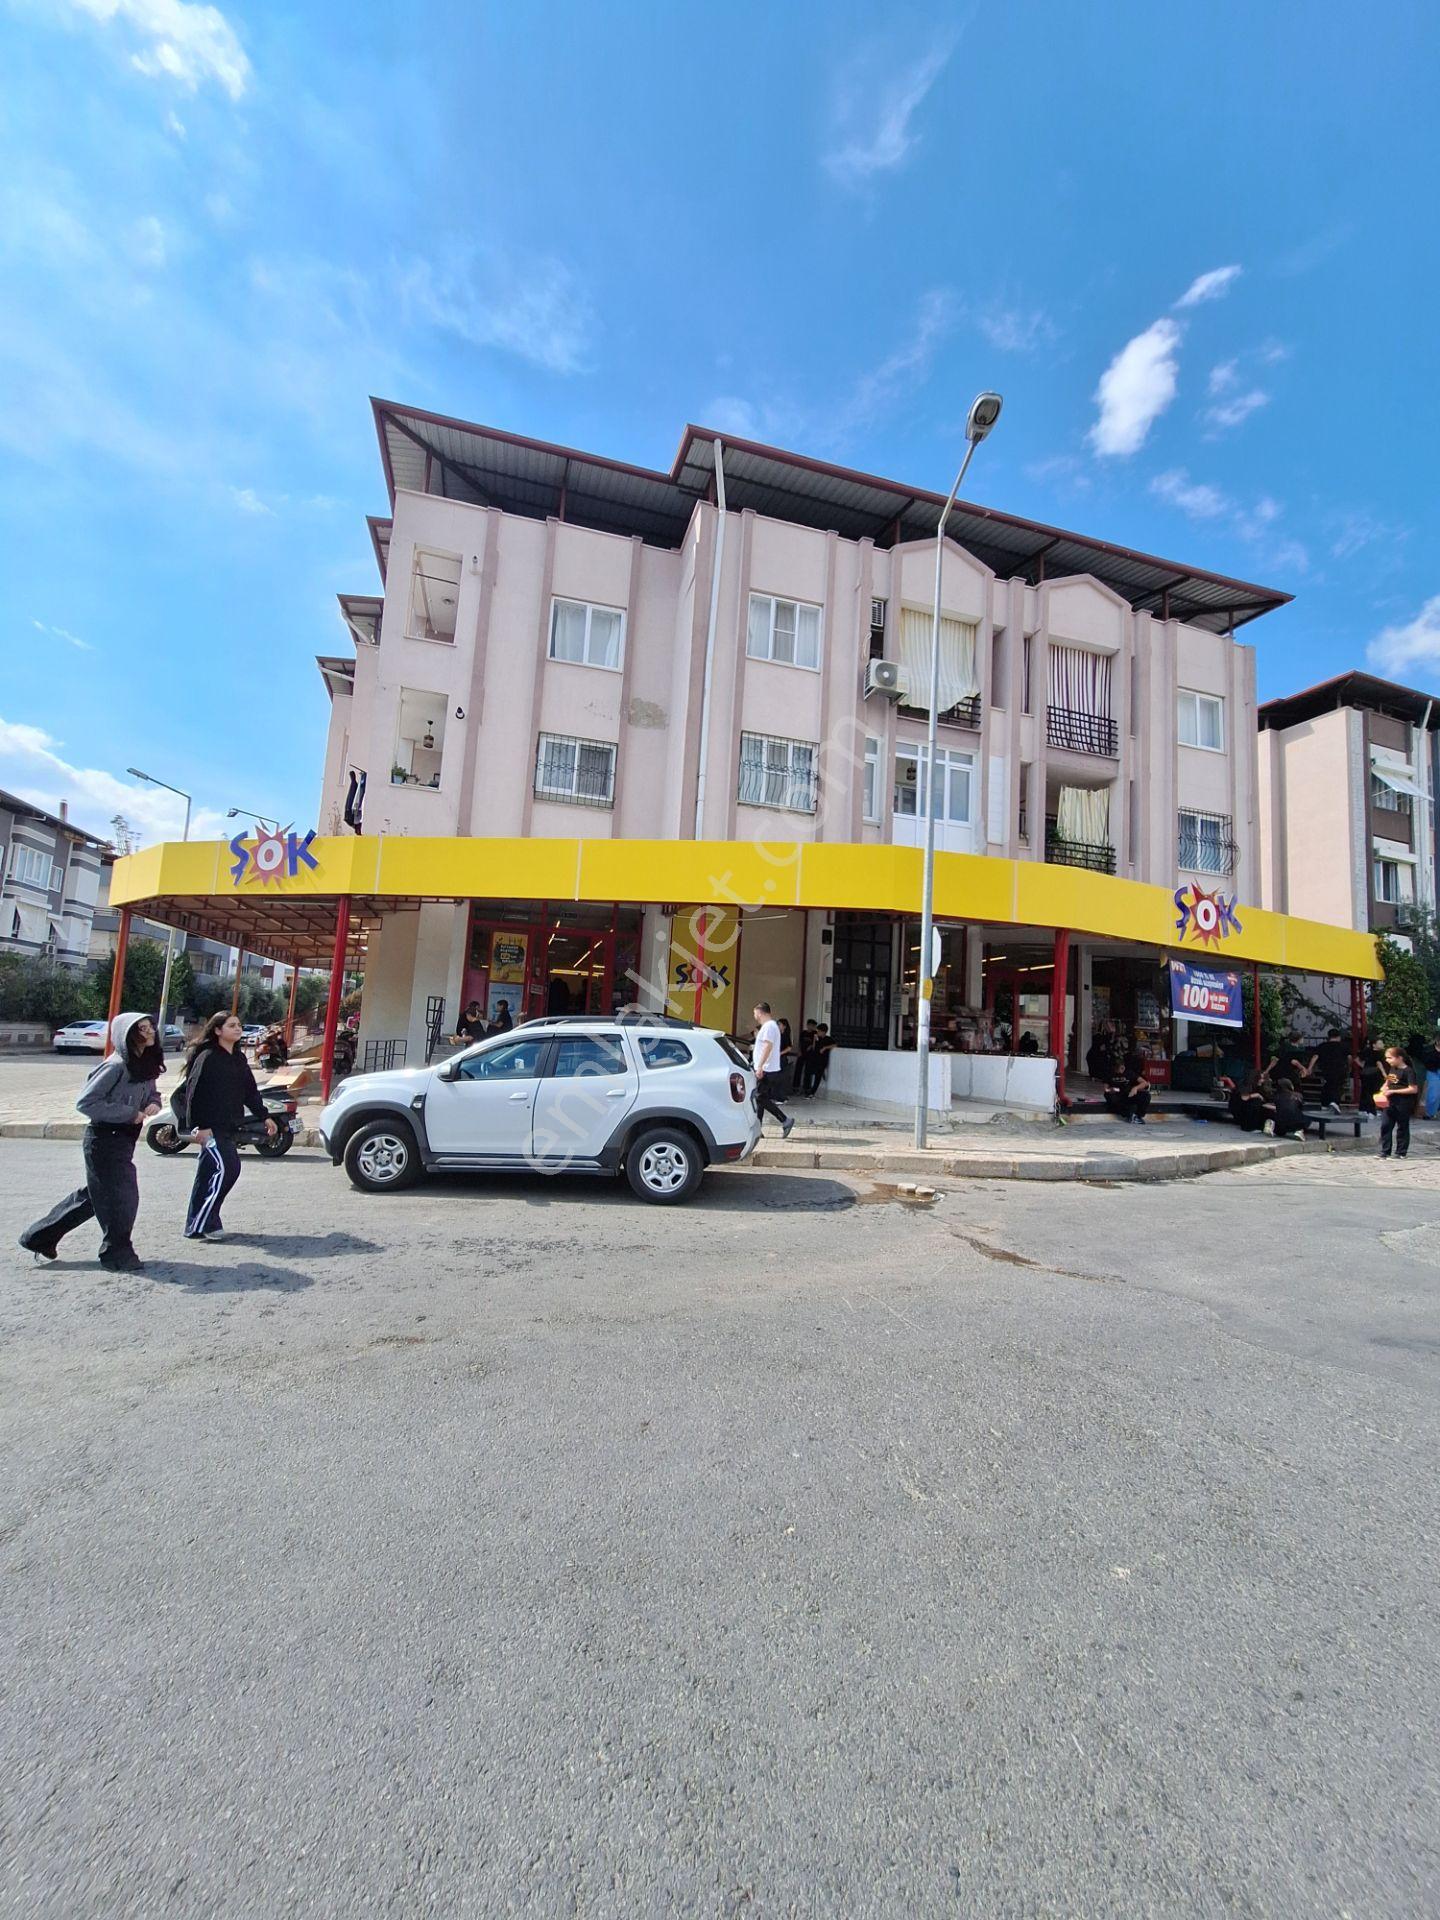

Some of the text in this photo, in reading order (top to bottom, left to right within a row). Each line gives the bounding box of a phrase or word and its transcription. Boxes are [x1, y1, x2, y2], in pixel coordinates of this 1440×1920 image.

[230, 828, 319, 887] ŞOK
[1174, 886, 1243, 942] ŞOK
[1183, 983, 1209, 1009] 100
